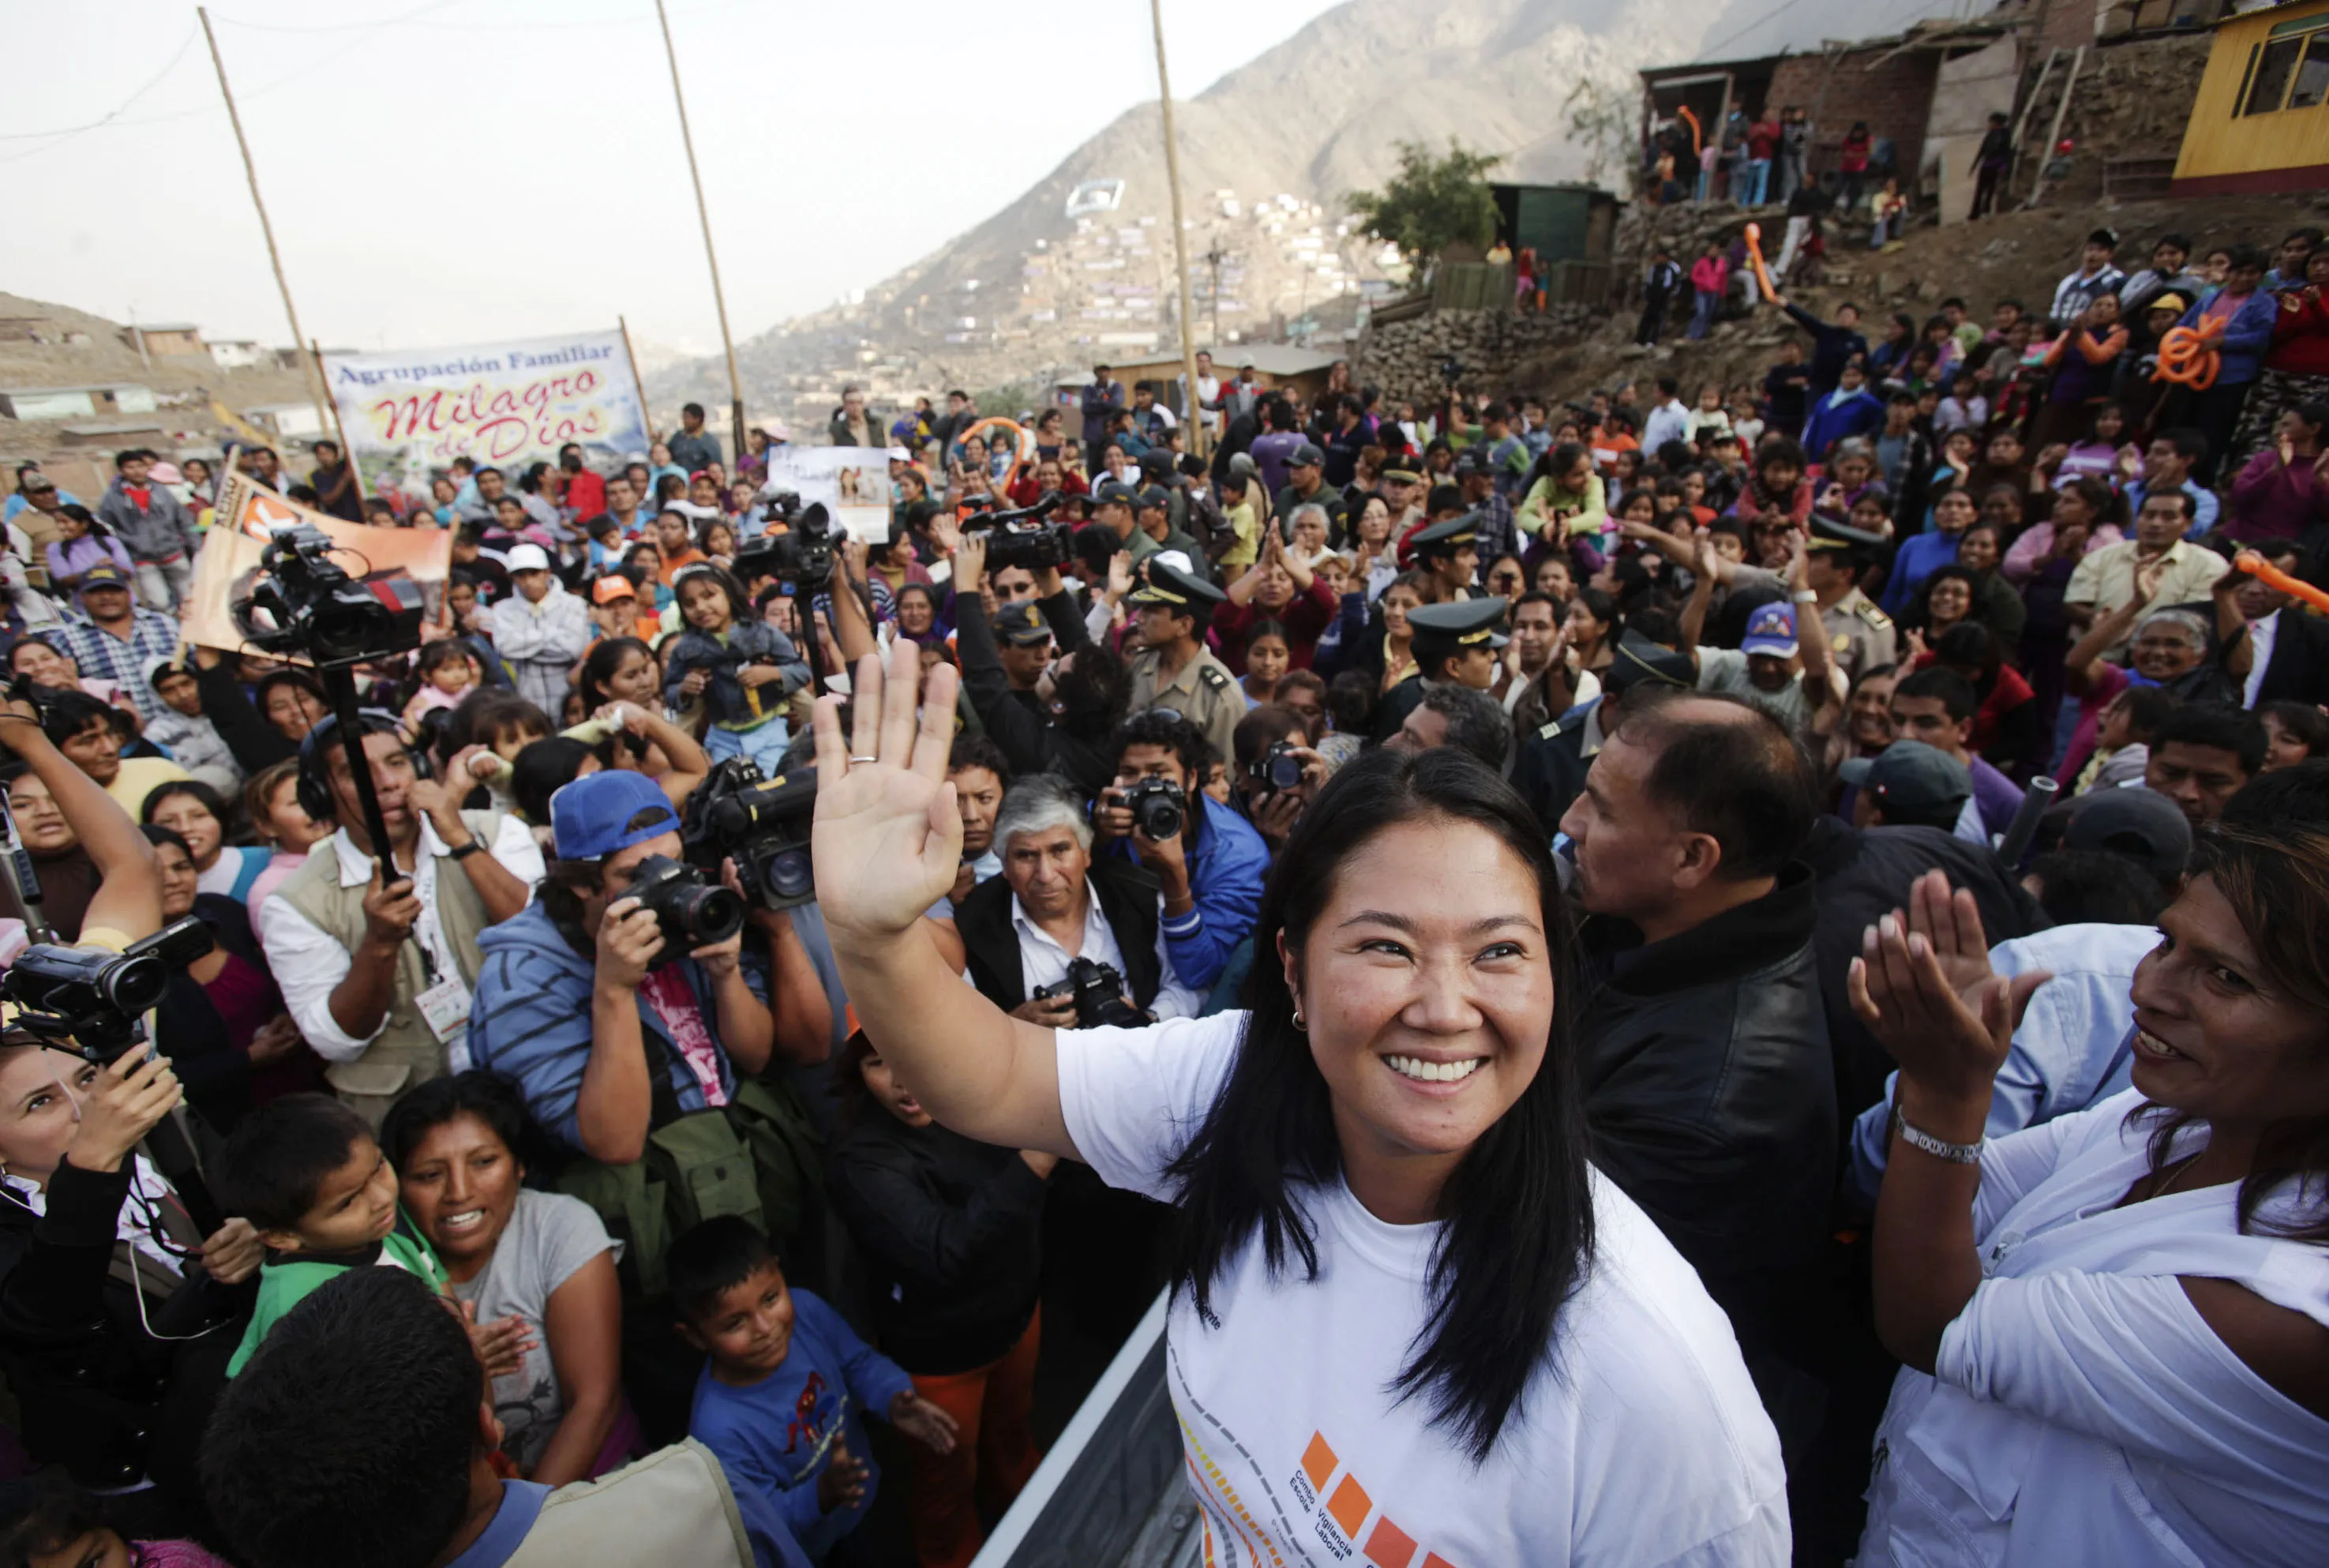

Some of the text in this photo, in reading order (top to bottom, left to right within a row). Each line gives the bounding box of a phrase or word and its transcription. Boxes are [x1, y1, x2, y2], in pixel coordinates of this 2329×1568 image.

[338, 344, 613, 385] Agrupación Familiar
[373, 370, 595, 439] Milagro
[433, 410, 598, 460] de Dios
[1289, 1477, 1311, 1514] Escolar
[1296, 1469, 1315, 1505] Combo
[1315, 1521, 1345, 1562] Laboral
[1318, 1507, 1353, 1557] Vigilancia
